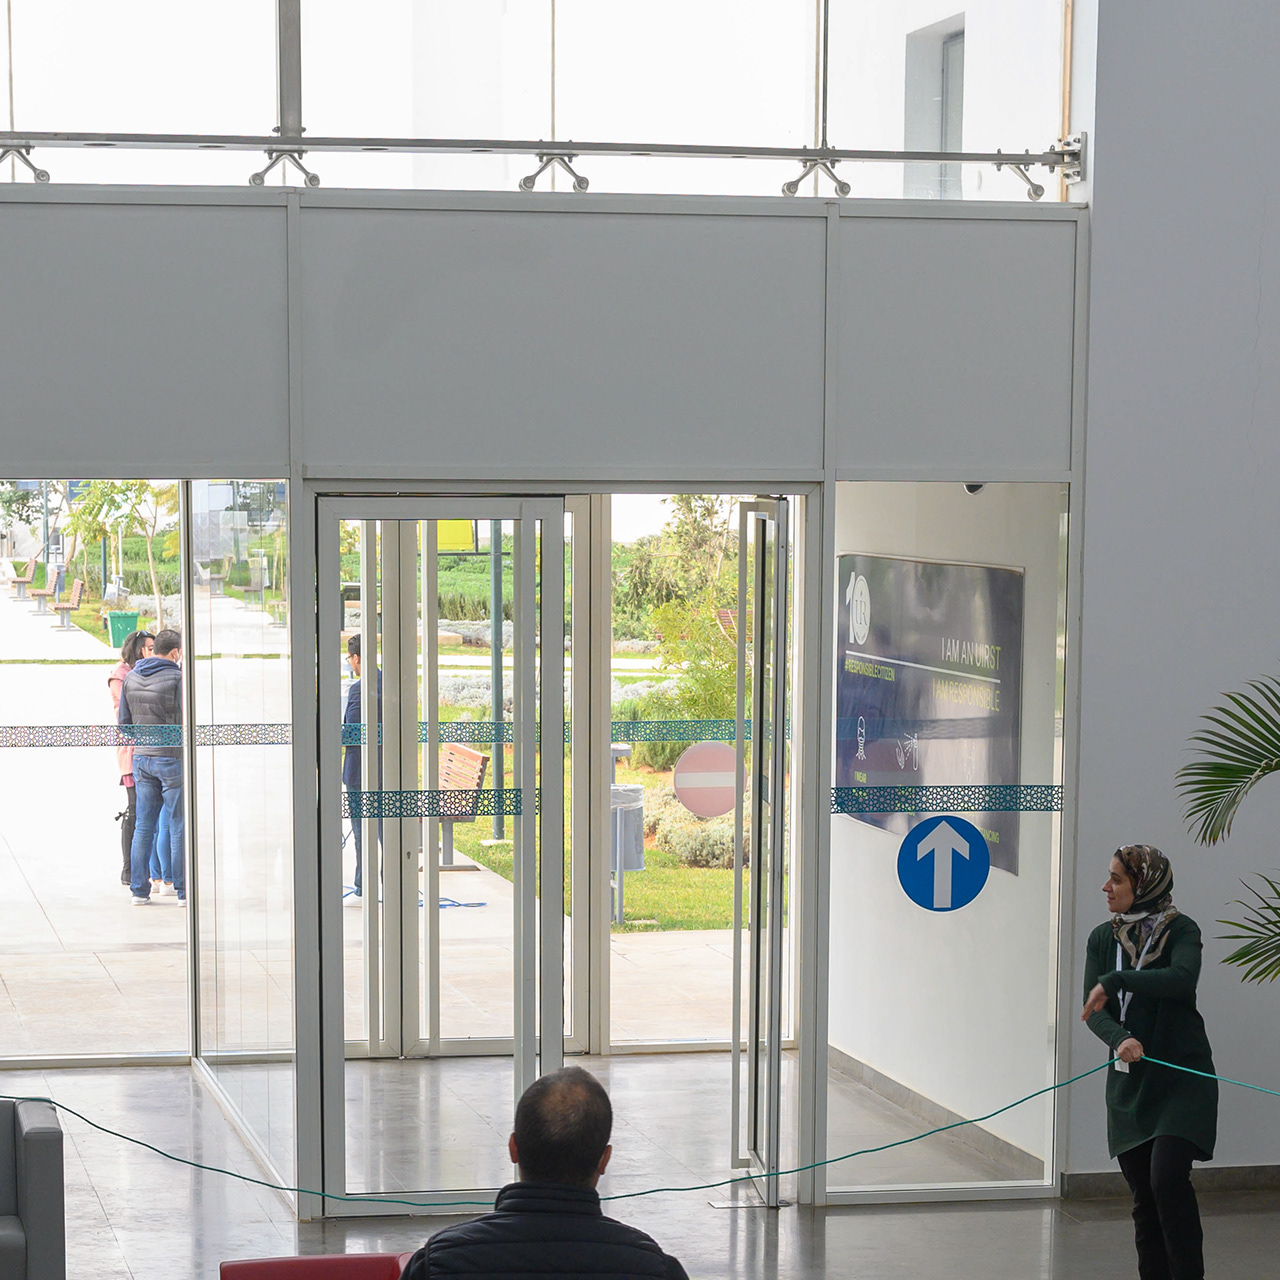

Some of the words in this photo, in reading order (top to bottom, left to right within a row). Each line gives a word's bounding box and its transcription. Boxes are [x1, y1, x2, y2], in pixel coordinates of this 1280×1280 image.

[941, 637, 945, 661] I
[945, 638, 960, 663] AM
[960, 641, 974, 666] AN
[932, 678, 936, 701] I
[936, 679, 949, 702] AM
[949, 681, 1000, 712] RESPONSIBLE
